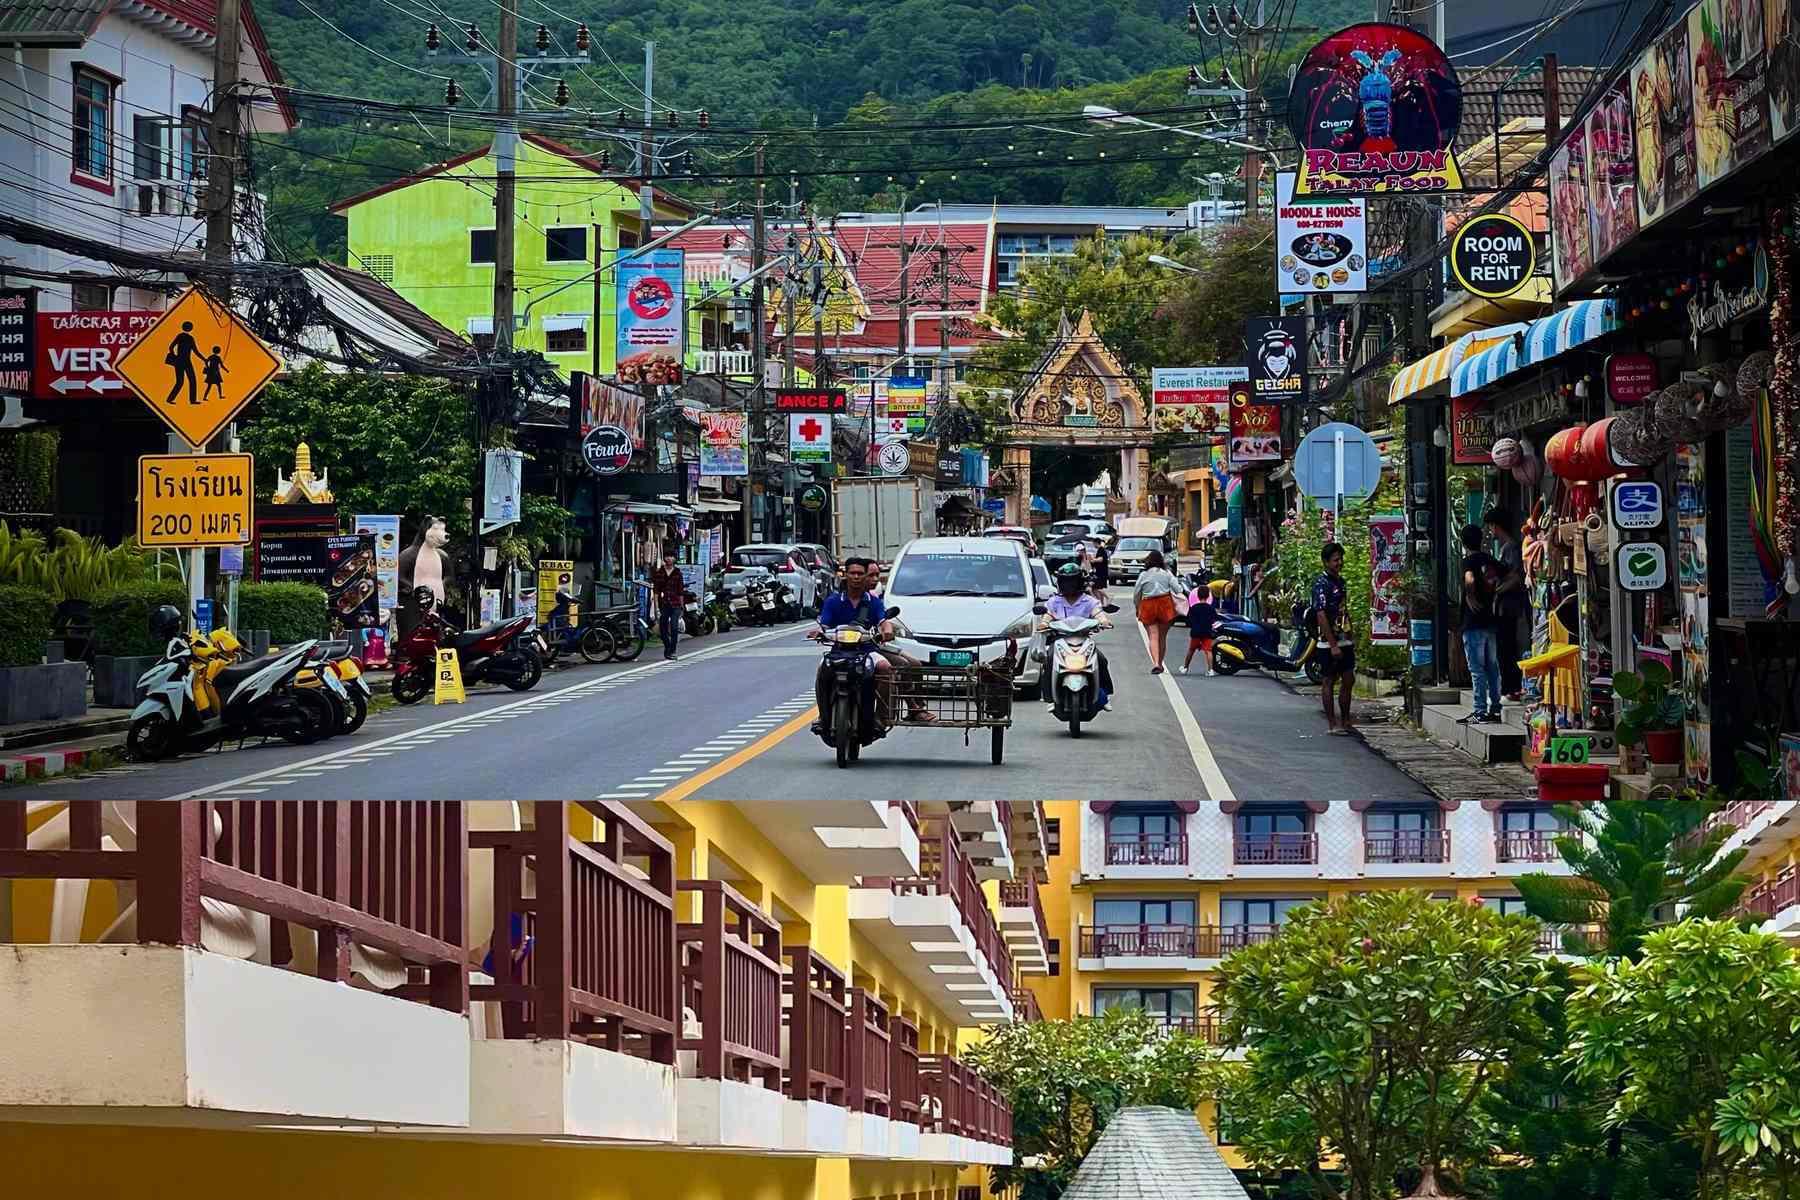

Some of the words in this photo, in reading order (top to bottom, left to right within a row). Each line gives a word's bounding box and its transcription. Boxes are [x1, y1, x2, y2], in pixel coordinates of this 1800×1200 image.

[1320, 120, 1354, 129] Cherry
[1305, 150, 1448, 174] REAUN
[1385, 175, 1448, 191] FOOD
[1280, 207, 1323, 218] NOODLE
[1326, 206, 1362, 217] HOUSE
[1464, 236, 1523, 252] ROOM
[1480, 252, 1509, 264] FOR
[1470, 265, 1521, 281] RENT
[51, 315, 121, 330] ТАЙСКАЯ
[100, 333, 144, 345] КУХН
[1159, 378, 1195, 389] Everest
[1255, 378, 1302, 390] GEISHA
[584, 438, 630, 459] Found
[148, 465, 243, 498] โรงเรียน
[150, 514, 192, 536] 200
[201, 513, 241, 534] เมตร
[1557, 739, 1584, 763] 60
